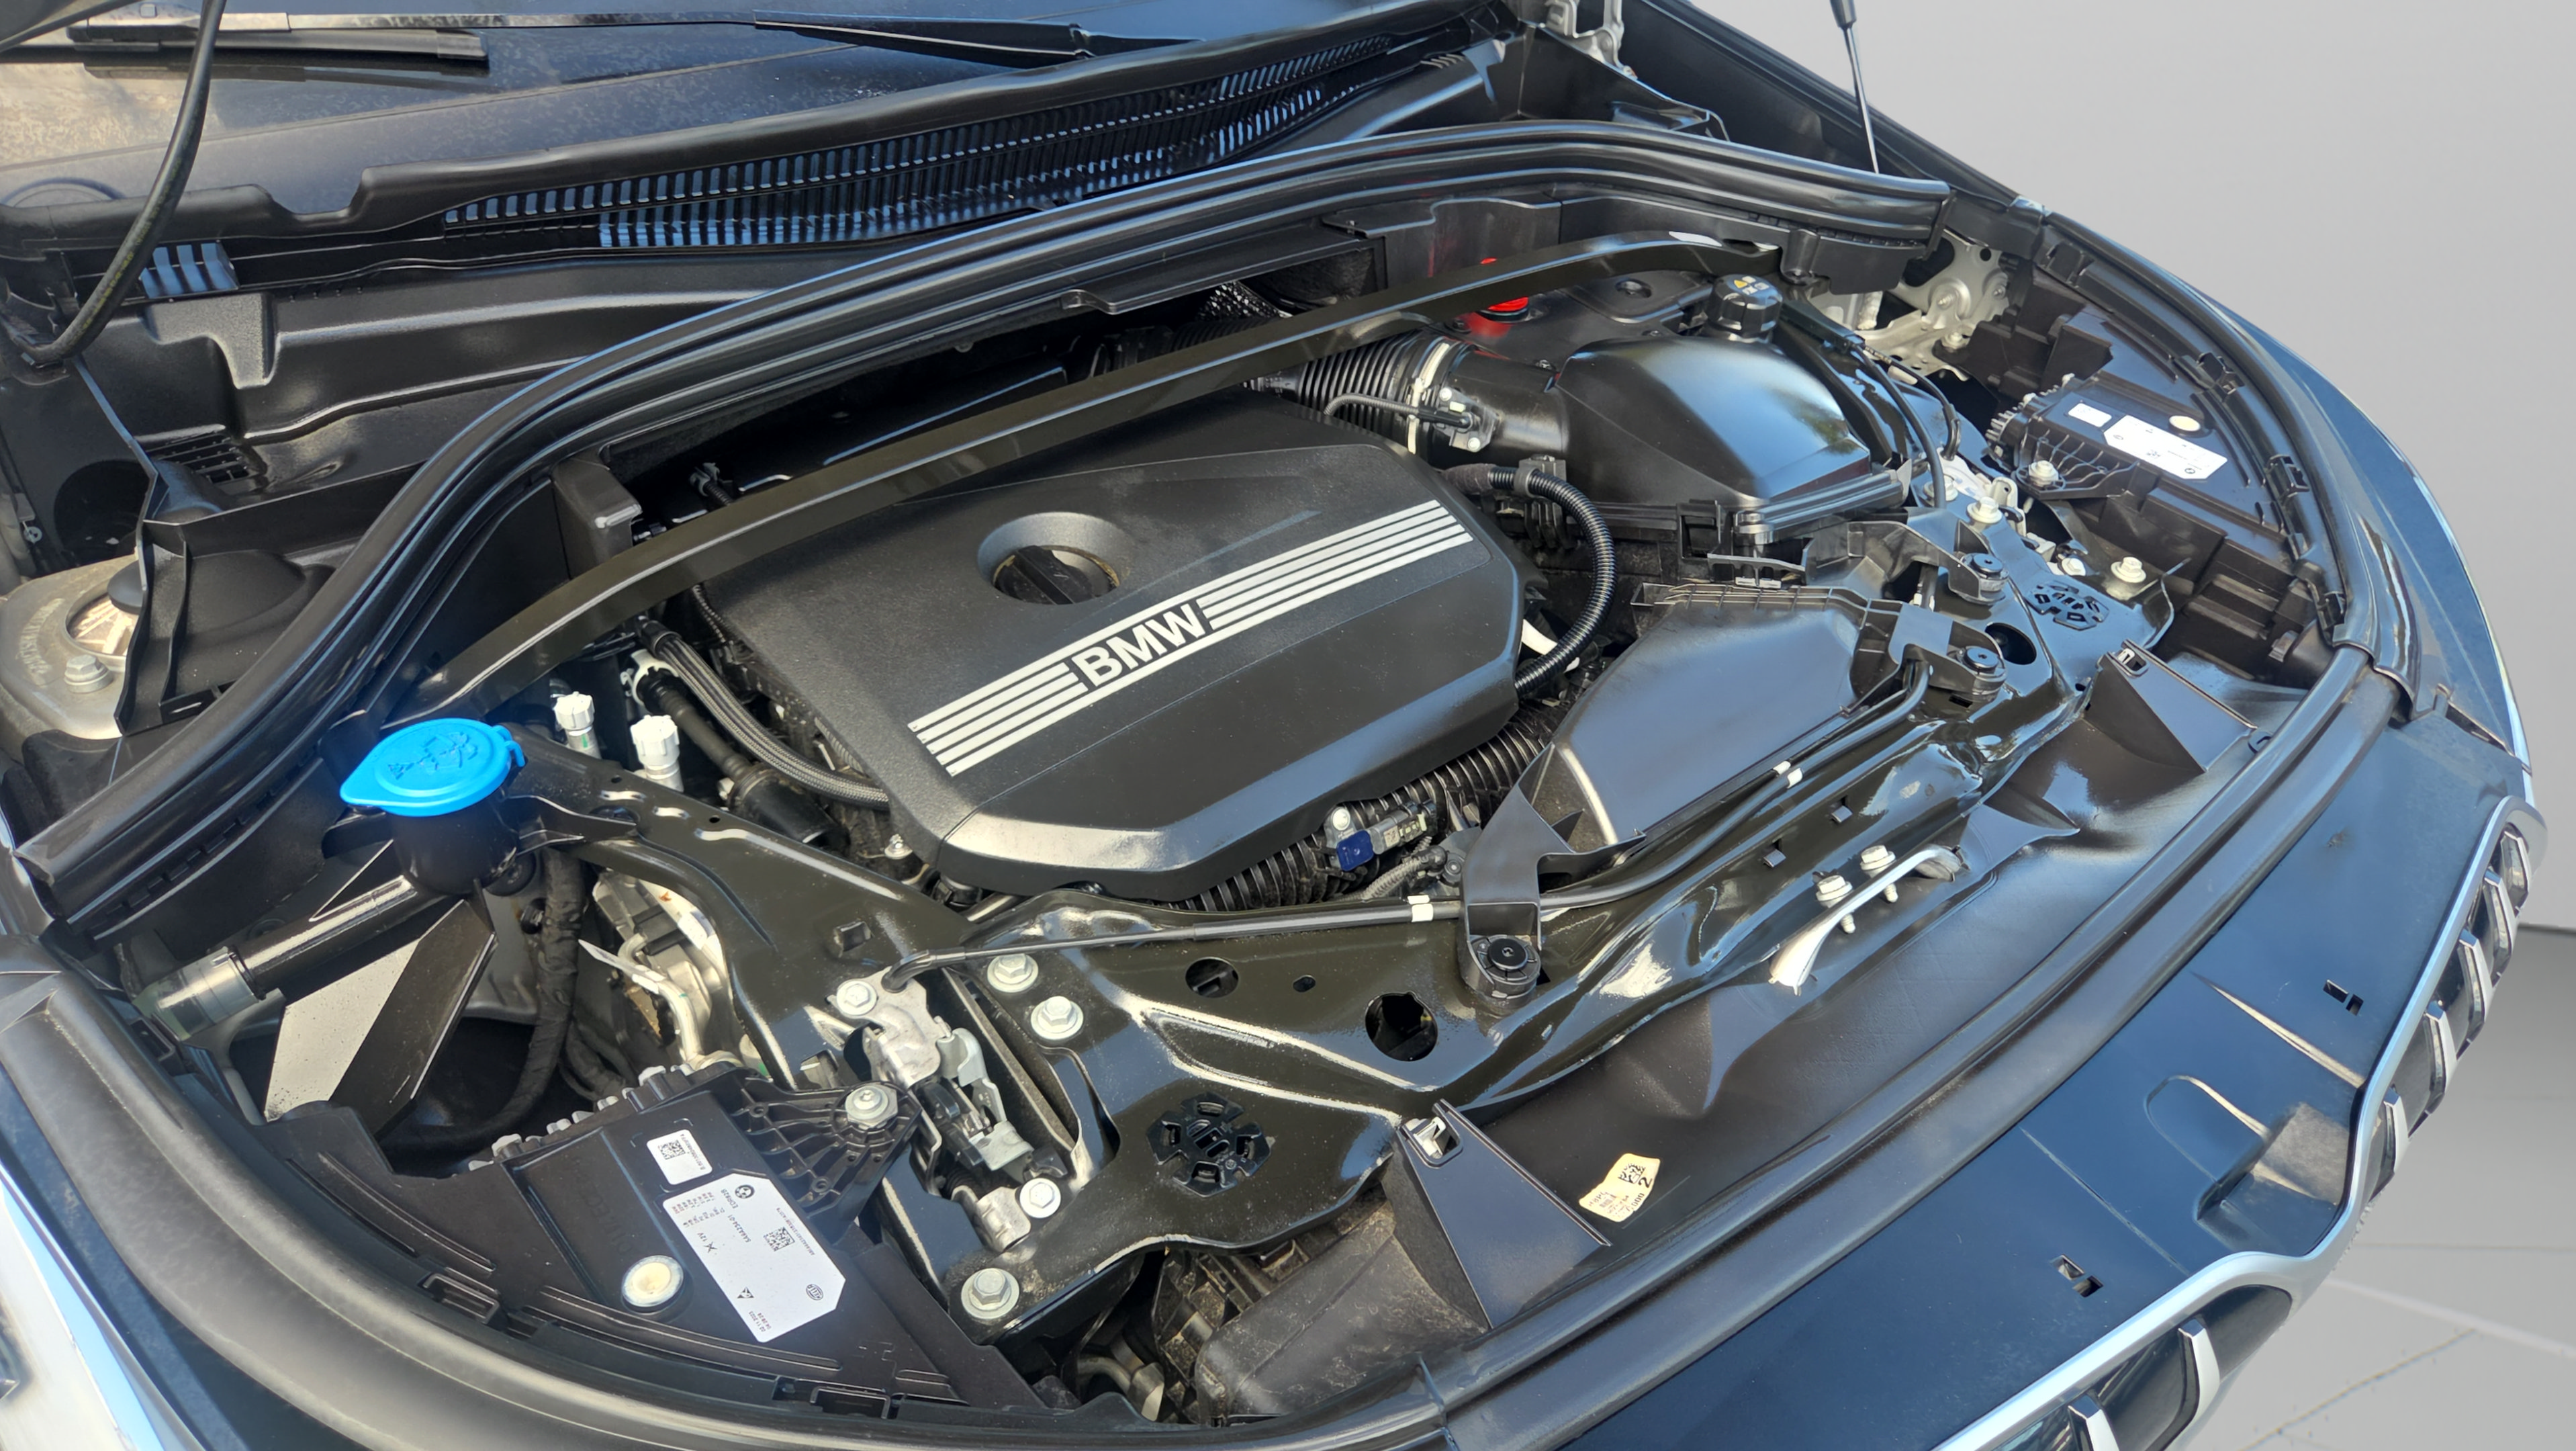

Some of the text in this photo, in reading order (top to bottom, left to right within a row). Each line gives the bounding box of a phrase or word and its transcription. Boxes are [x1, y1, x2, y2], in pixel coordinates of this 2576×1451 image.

[1071, 603, 1205, 687] BMW
[1638, 1176, 1653, 1188] 2
[697, 1233, 708, 1241] 12V
